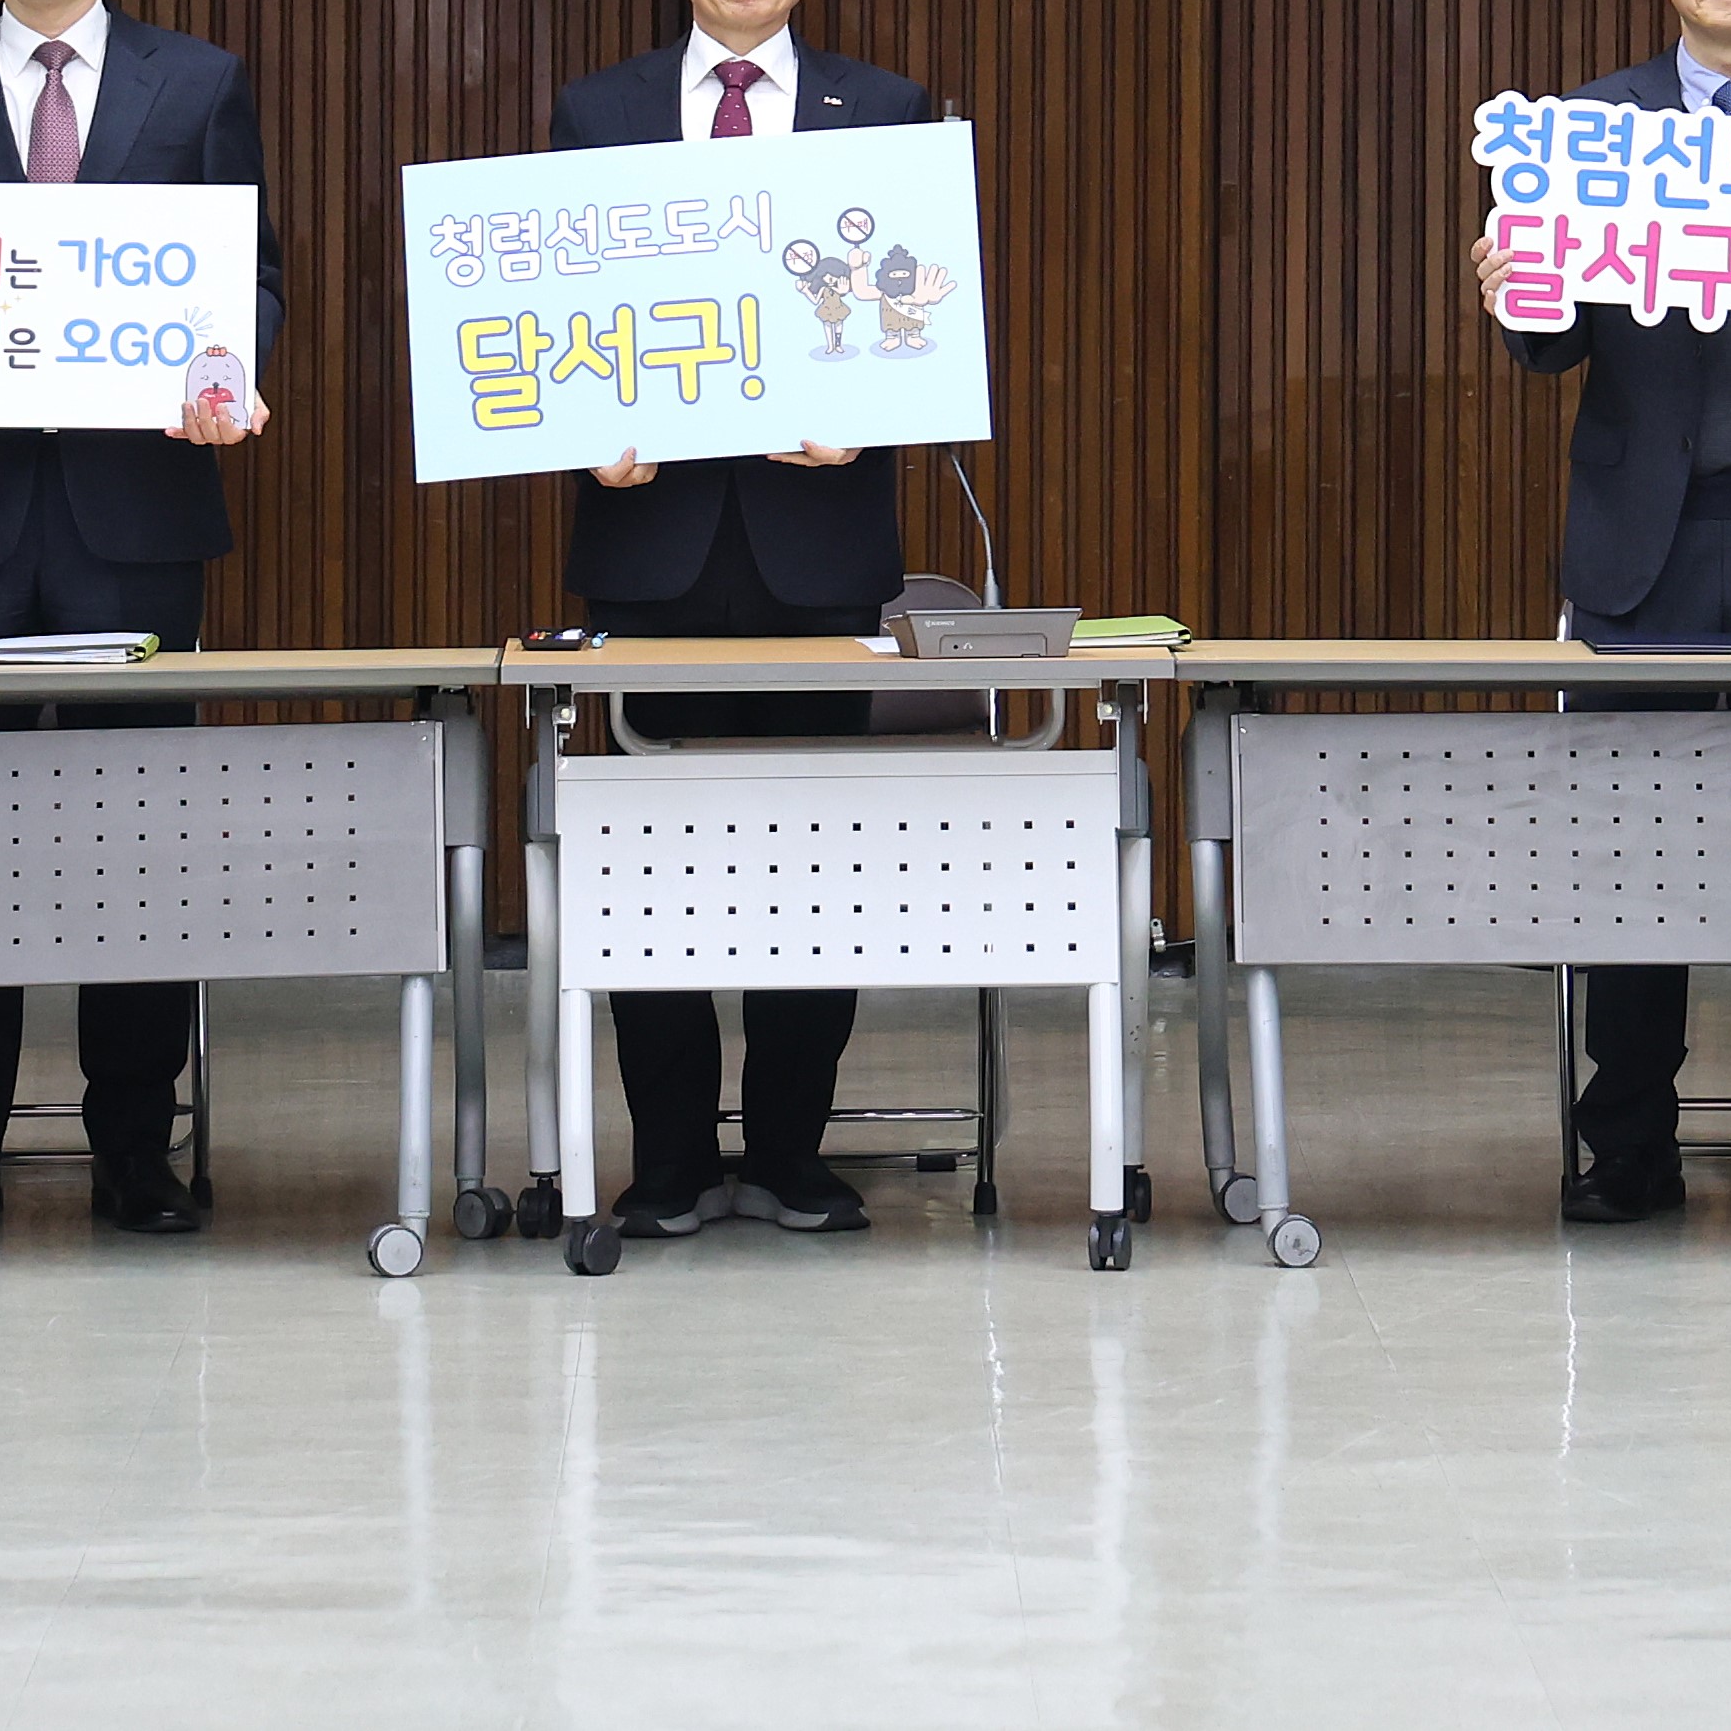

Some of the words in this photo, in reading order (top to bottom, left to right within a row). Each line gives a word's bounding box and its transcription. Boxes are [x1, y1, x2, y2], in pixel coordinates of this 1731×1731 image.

[58, 237, 197, 288] 가GO
[429, 190, 773, 287] 청렴선도도시
[55, 319, 196, 367] 오GO
[457, 293, 766, 431] 달서구!
